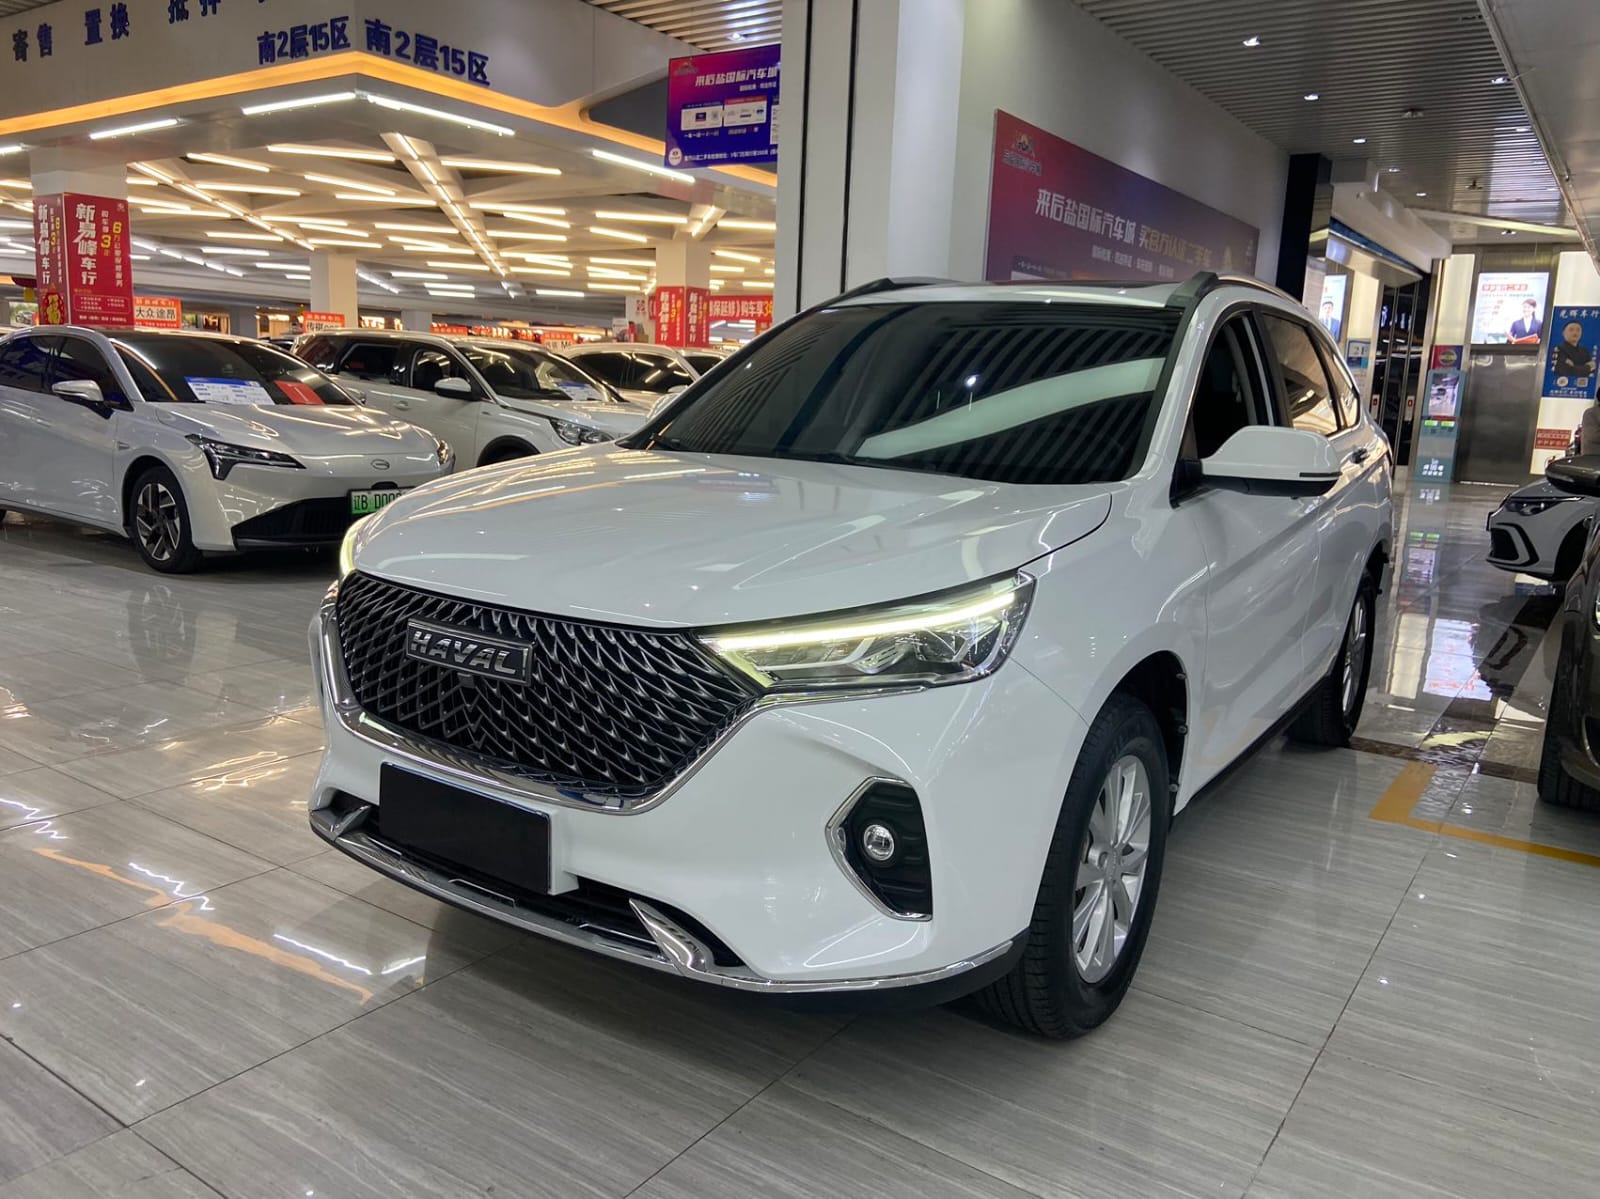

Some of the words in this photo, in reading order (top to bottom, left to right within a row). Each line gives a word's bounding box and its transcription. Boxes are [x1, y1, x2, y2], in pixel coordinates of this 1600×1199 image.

[84, 2, 130, 46] 置换
[257, 16, 351, 65] 南2层15区
[365, 18, 490, 86] 南2层15区
[1035, 188, 1136, 245] 来后盐国际汽车城
[136, 307, 175, 321] 大众途昂
[411, 630, 516, 675] HAVAL
